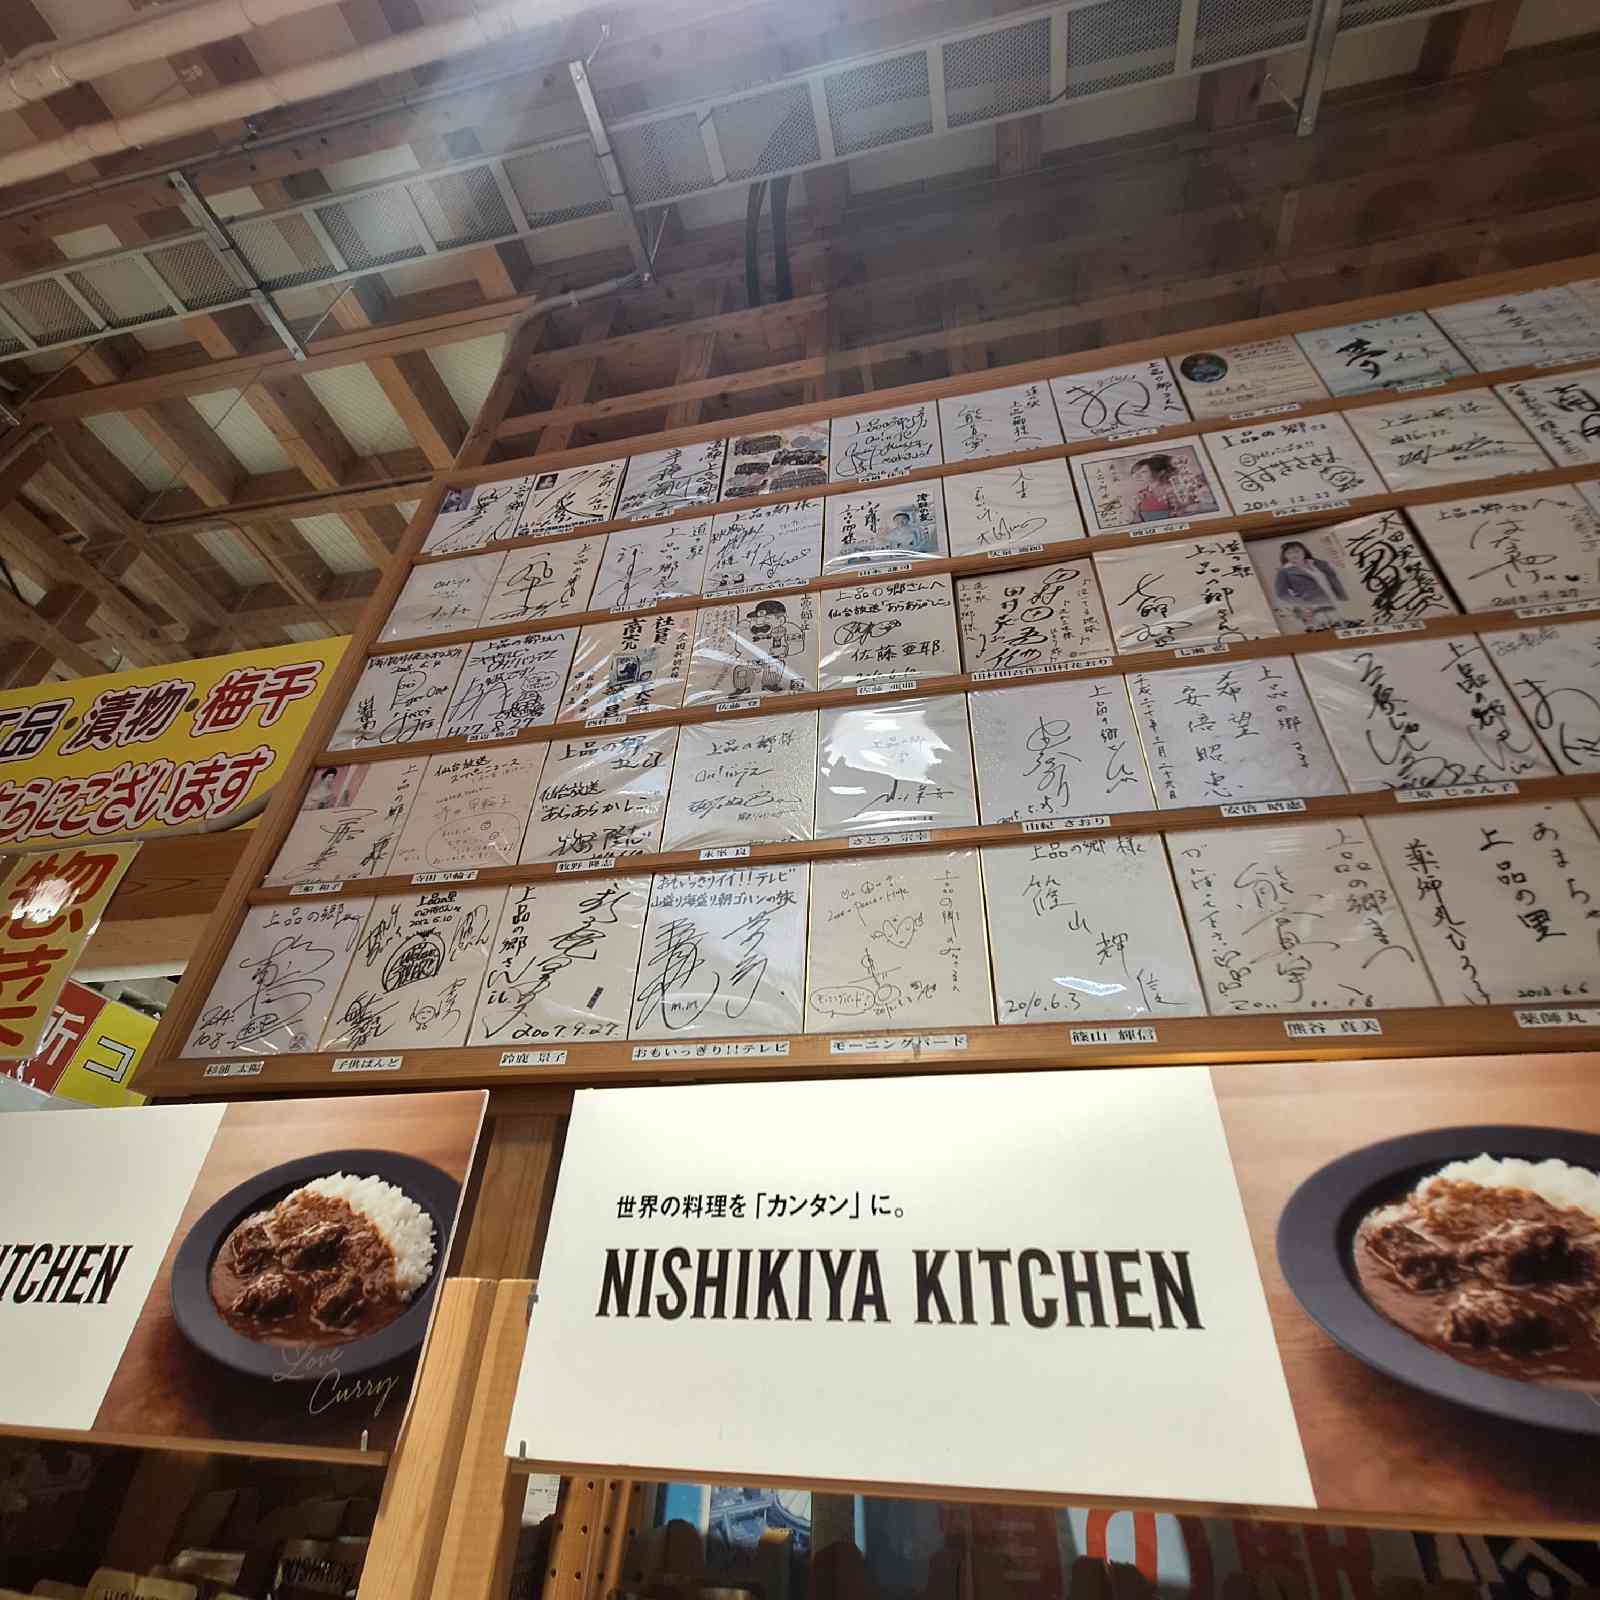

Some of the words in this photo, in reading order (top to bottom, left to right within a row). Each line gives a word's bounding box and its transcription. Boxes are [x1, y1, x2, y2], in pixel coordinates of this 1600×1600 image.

[616, 1191, 904, 1219] 世界の料理を「カンタン」に。
[595, 1246, 892, 1324] NISHIKIYA
[912, 1247, 1206, 1331] KITCHEN
[272, 1344, 345, 1383] Love
[308, 1367, 400, 1417] Curry
